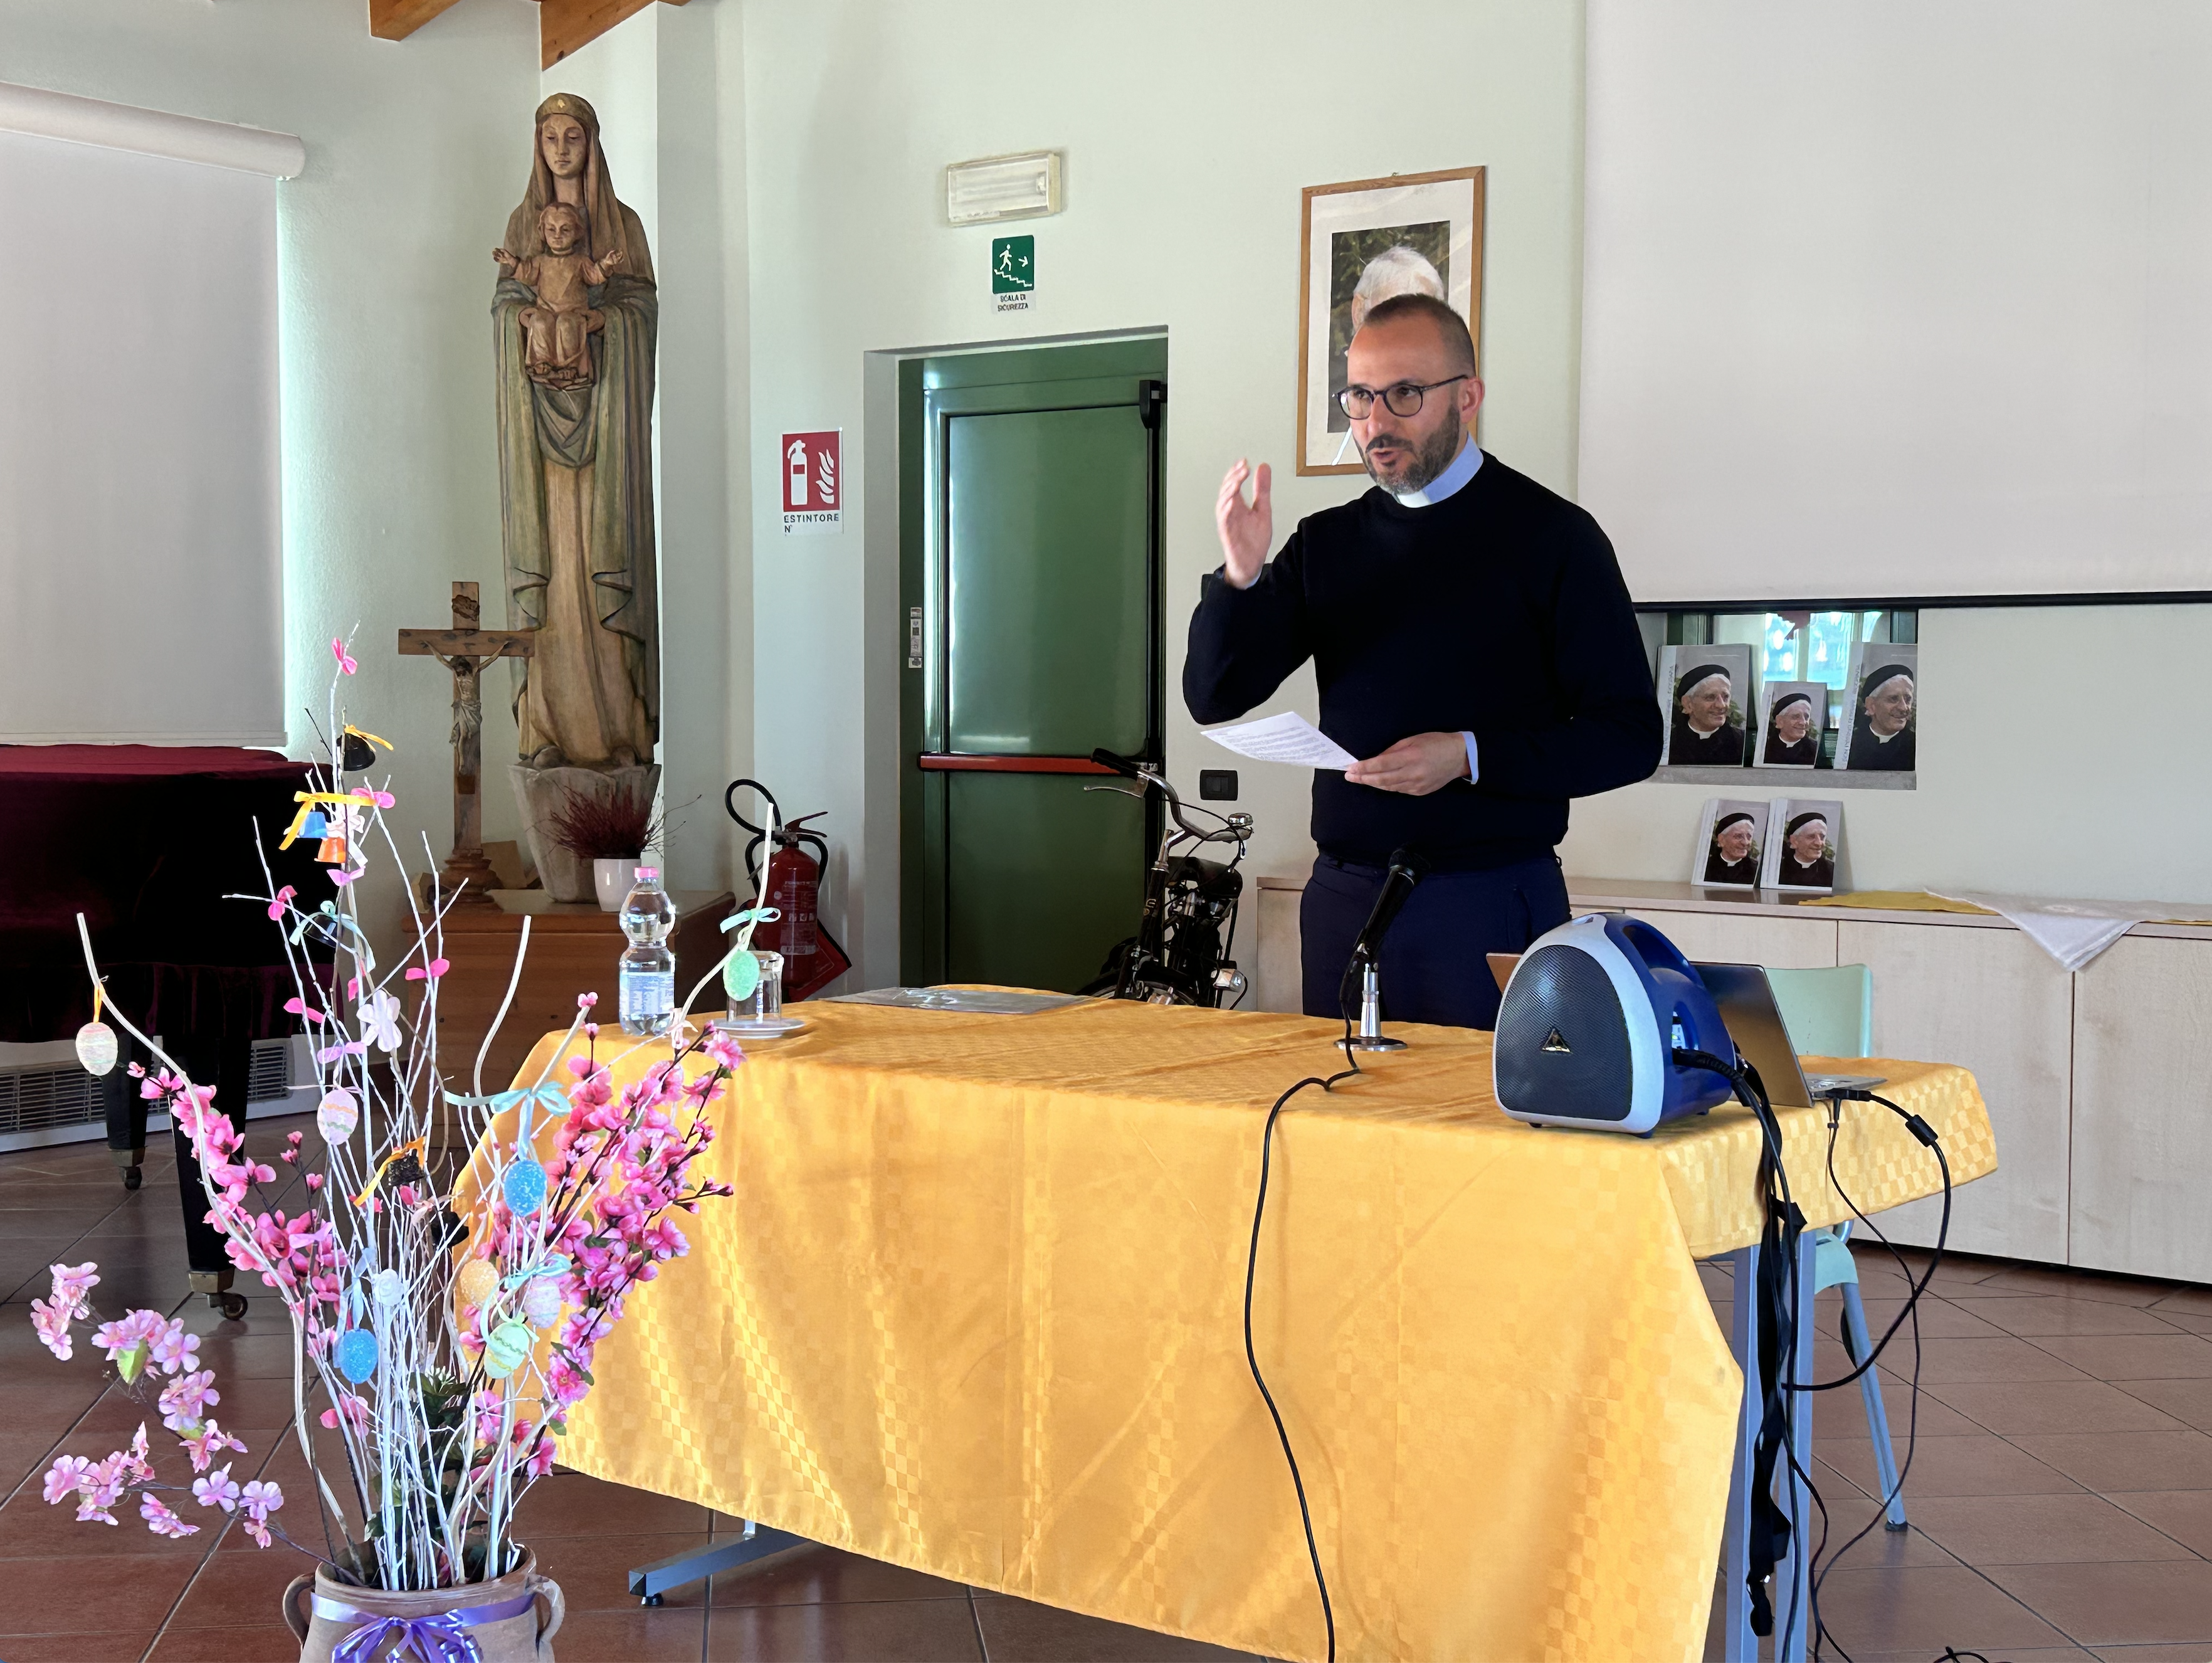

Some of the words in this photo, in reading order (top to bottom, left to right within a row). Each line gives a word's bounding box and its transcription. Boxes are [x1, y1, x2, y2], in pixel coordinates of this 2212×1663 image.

[1000, 294, 1019, 302] SCALA
[998, 303, 1028, 312] SICUREZZA
[784, 513, 840, 523] ESTINTORE
